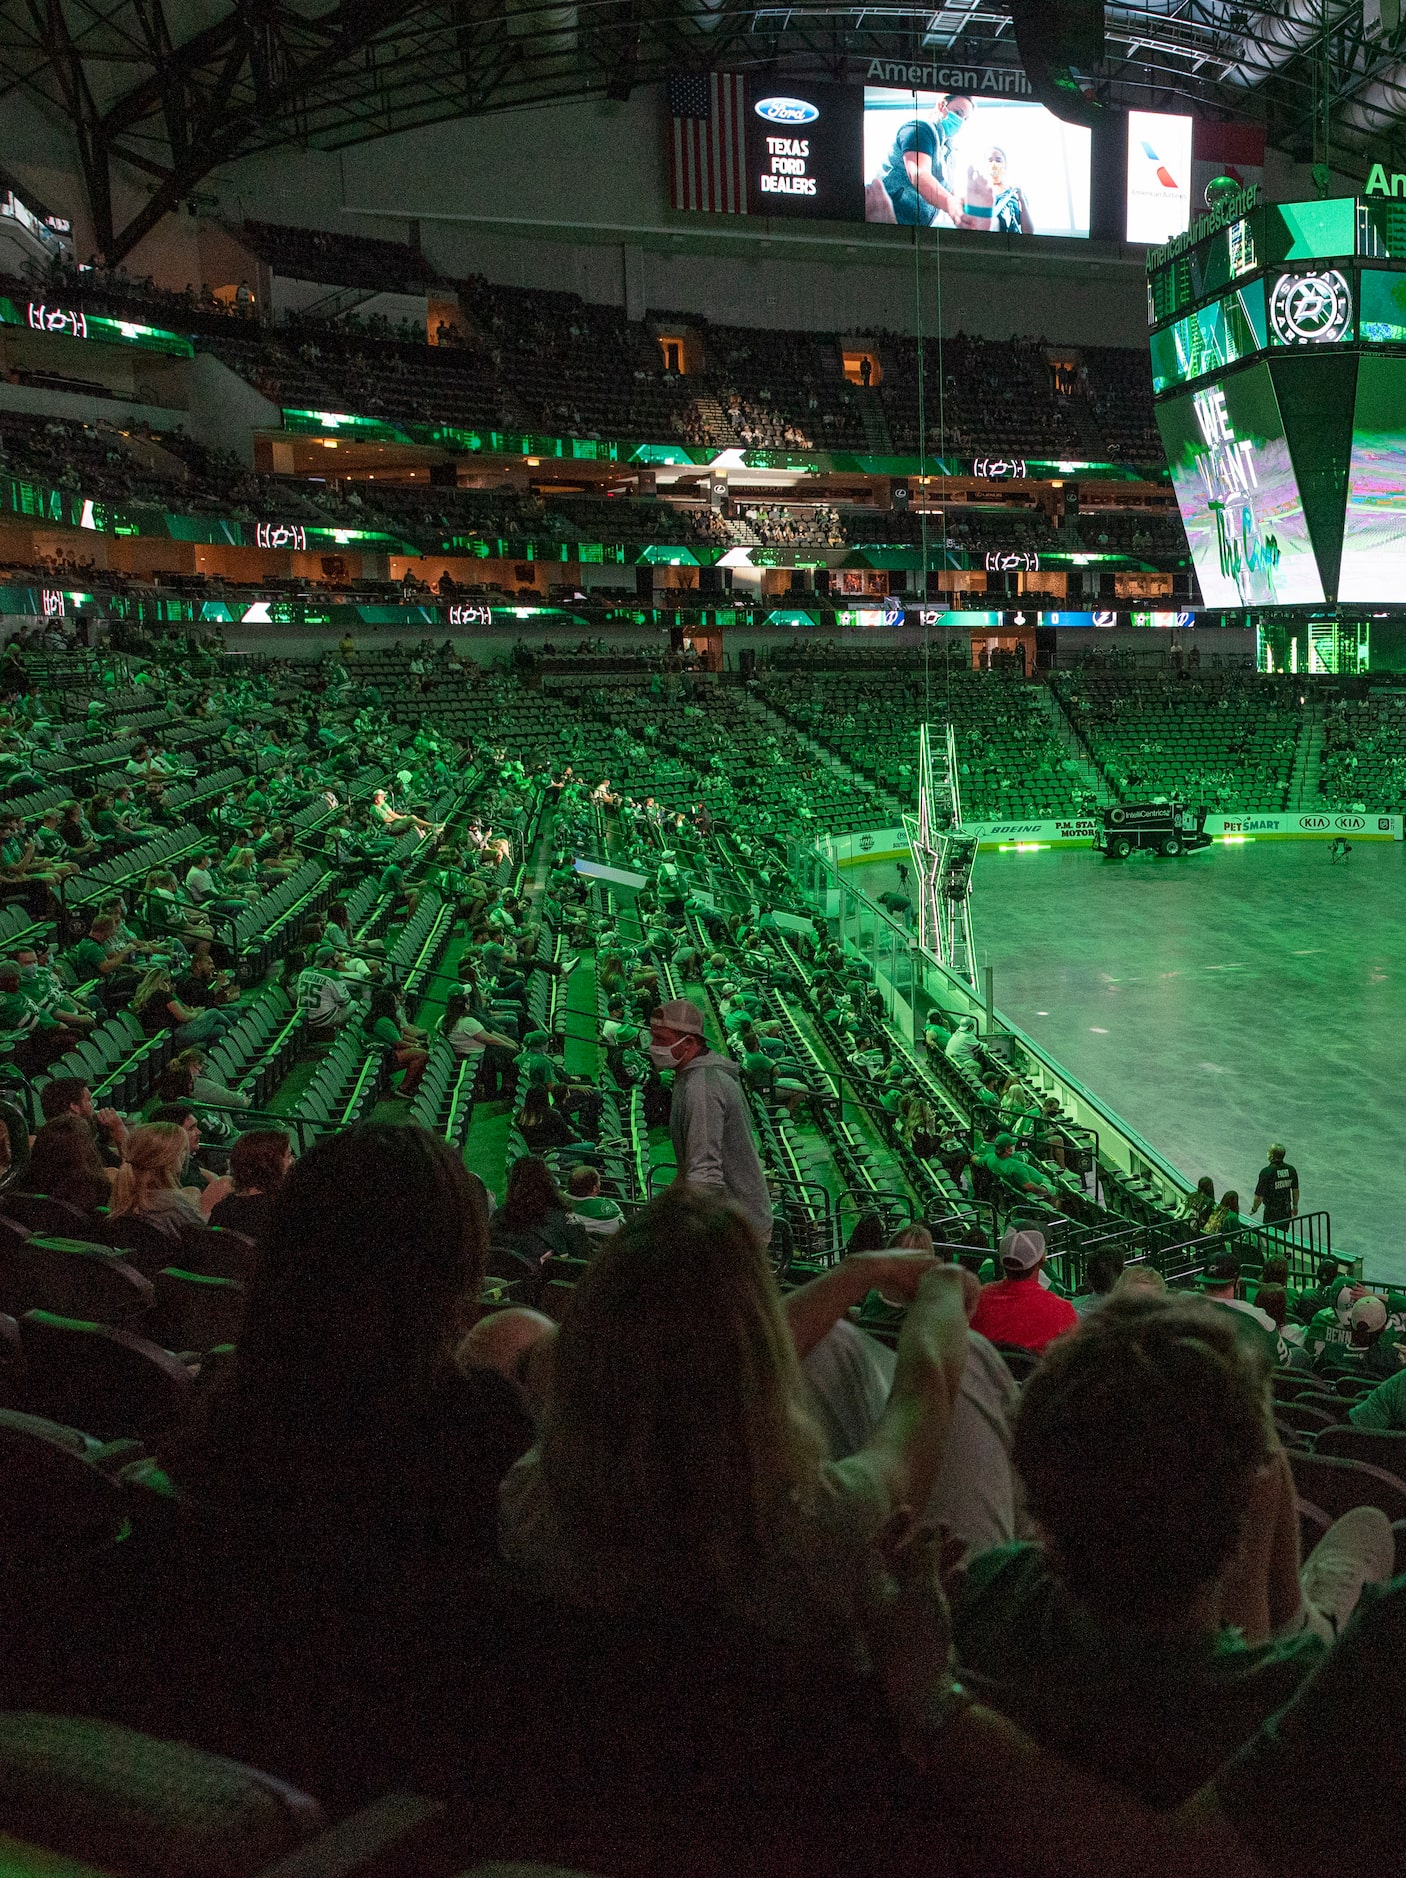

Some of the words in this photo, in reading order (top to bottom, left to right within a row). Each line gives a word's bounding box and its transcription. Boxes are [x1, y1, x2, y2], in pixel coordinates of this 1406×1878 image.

[867, 59, 977, 88] American
[767, 100, 806, 121] Ford
[766, 136, 810, 158] TEXAS
[771, 157, 806, 176] FORD
[760, 174, 817, 196] DEALERS
[1131, 188, 1161, 198] American
[1193, 390, 1235, 446] WE
[1195, 439, 1258, 499] WANT
[1051, 613, 1059, 624] 0
[990, 825, 1042, 834] BOEING
[1303, 818, 1325, 828] KIA
[1340, 818, 1361, 828] KIA
[299, 983, 323, 1008] 25
